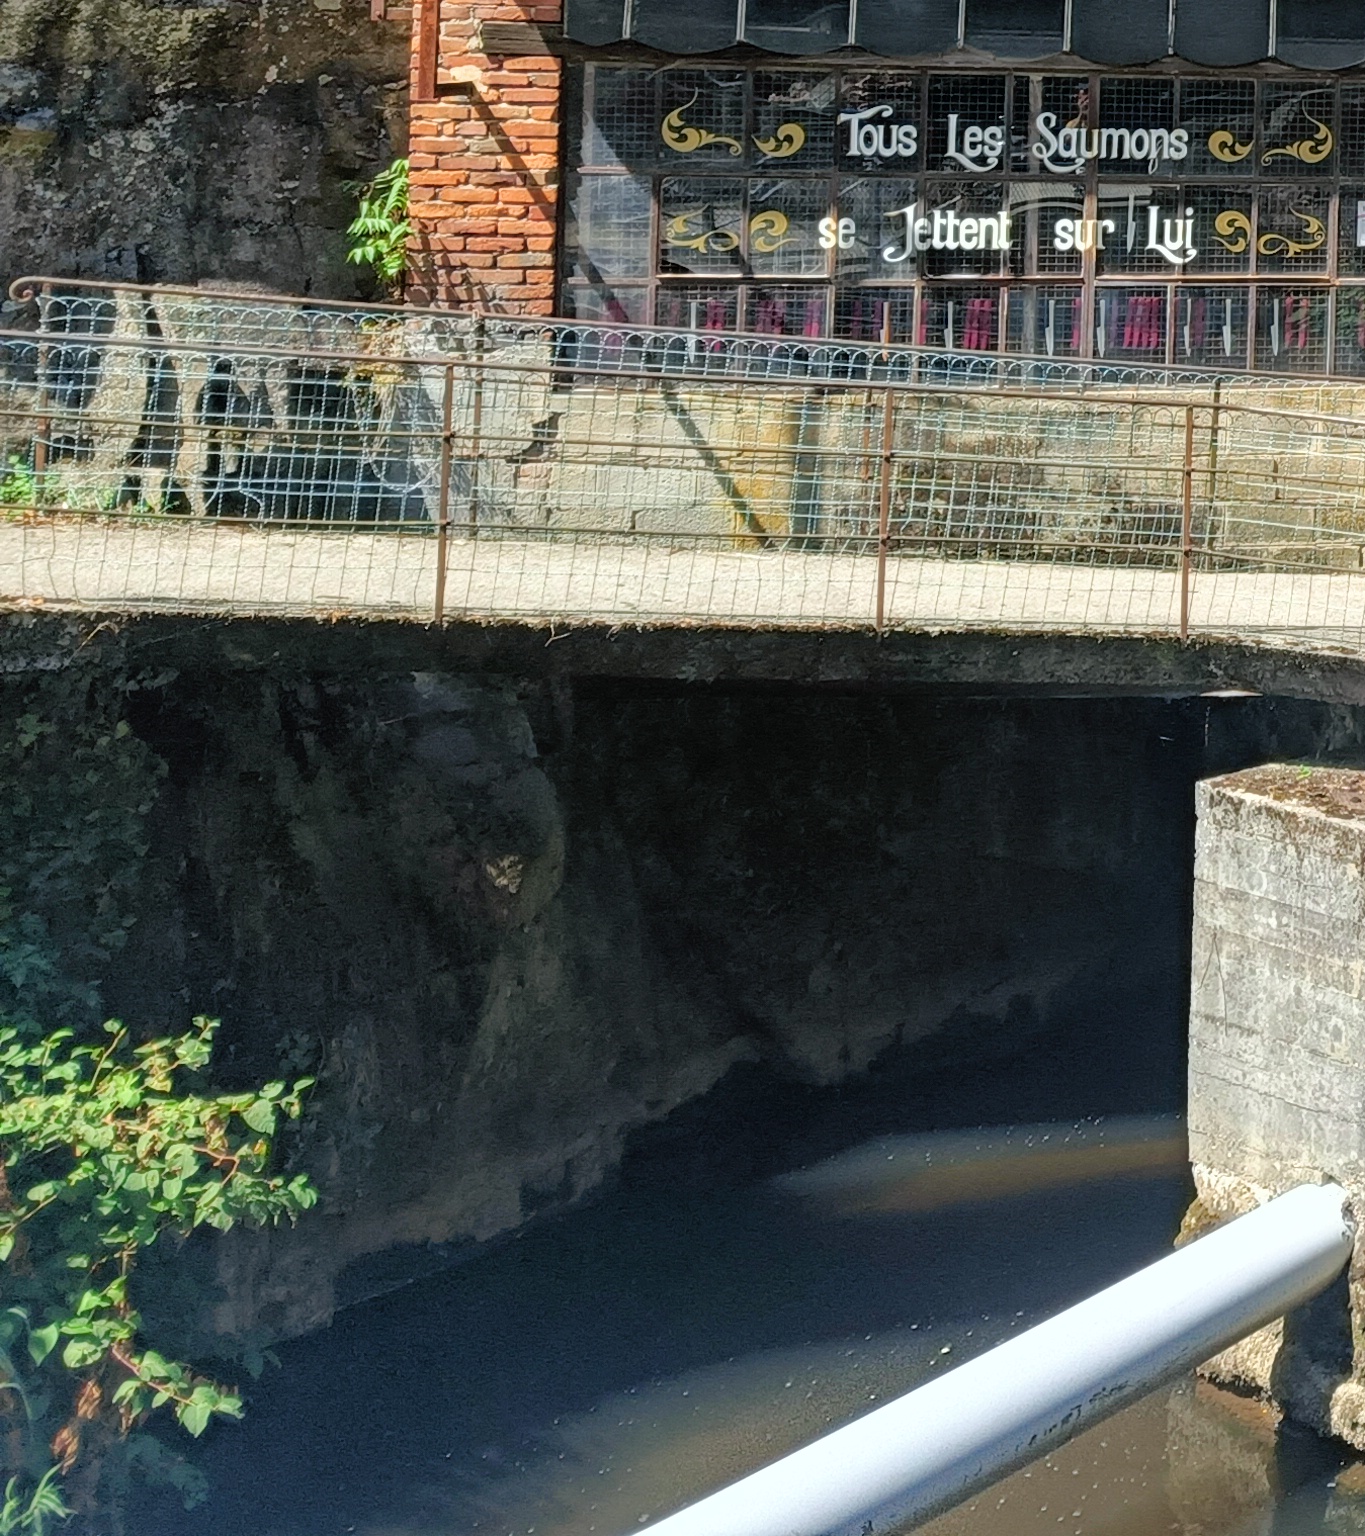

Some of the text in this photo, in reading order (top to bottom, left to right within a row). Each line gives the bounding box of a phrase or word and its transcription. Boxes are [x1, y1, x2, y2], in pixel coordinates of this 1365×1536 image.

[837, 105, 1188, 175] Tous Les Saumons
[818, 202, 1197, 264] se Jettent sur Lui
